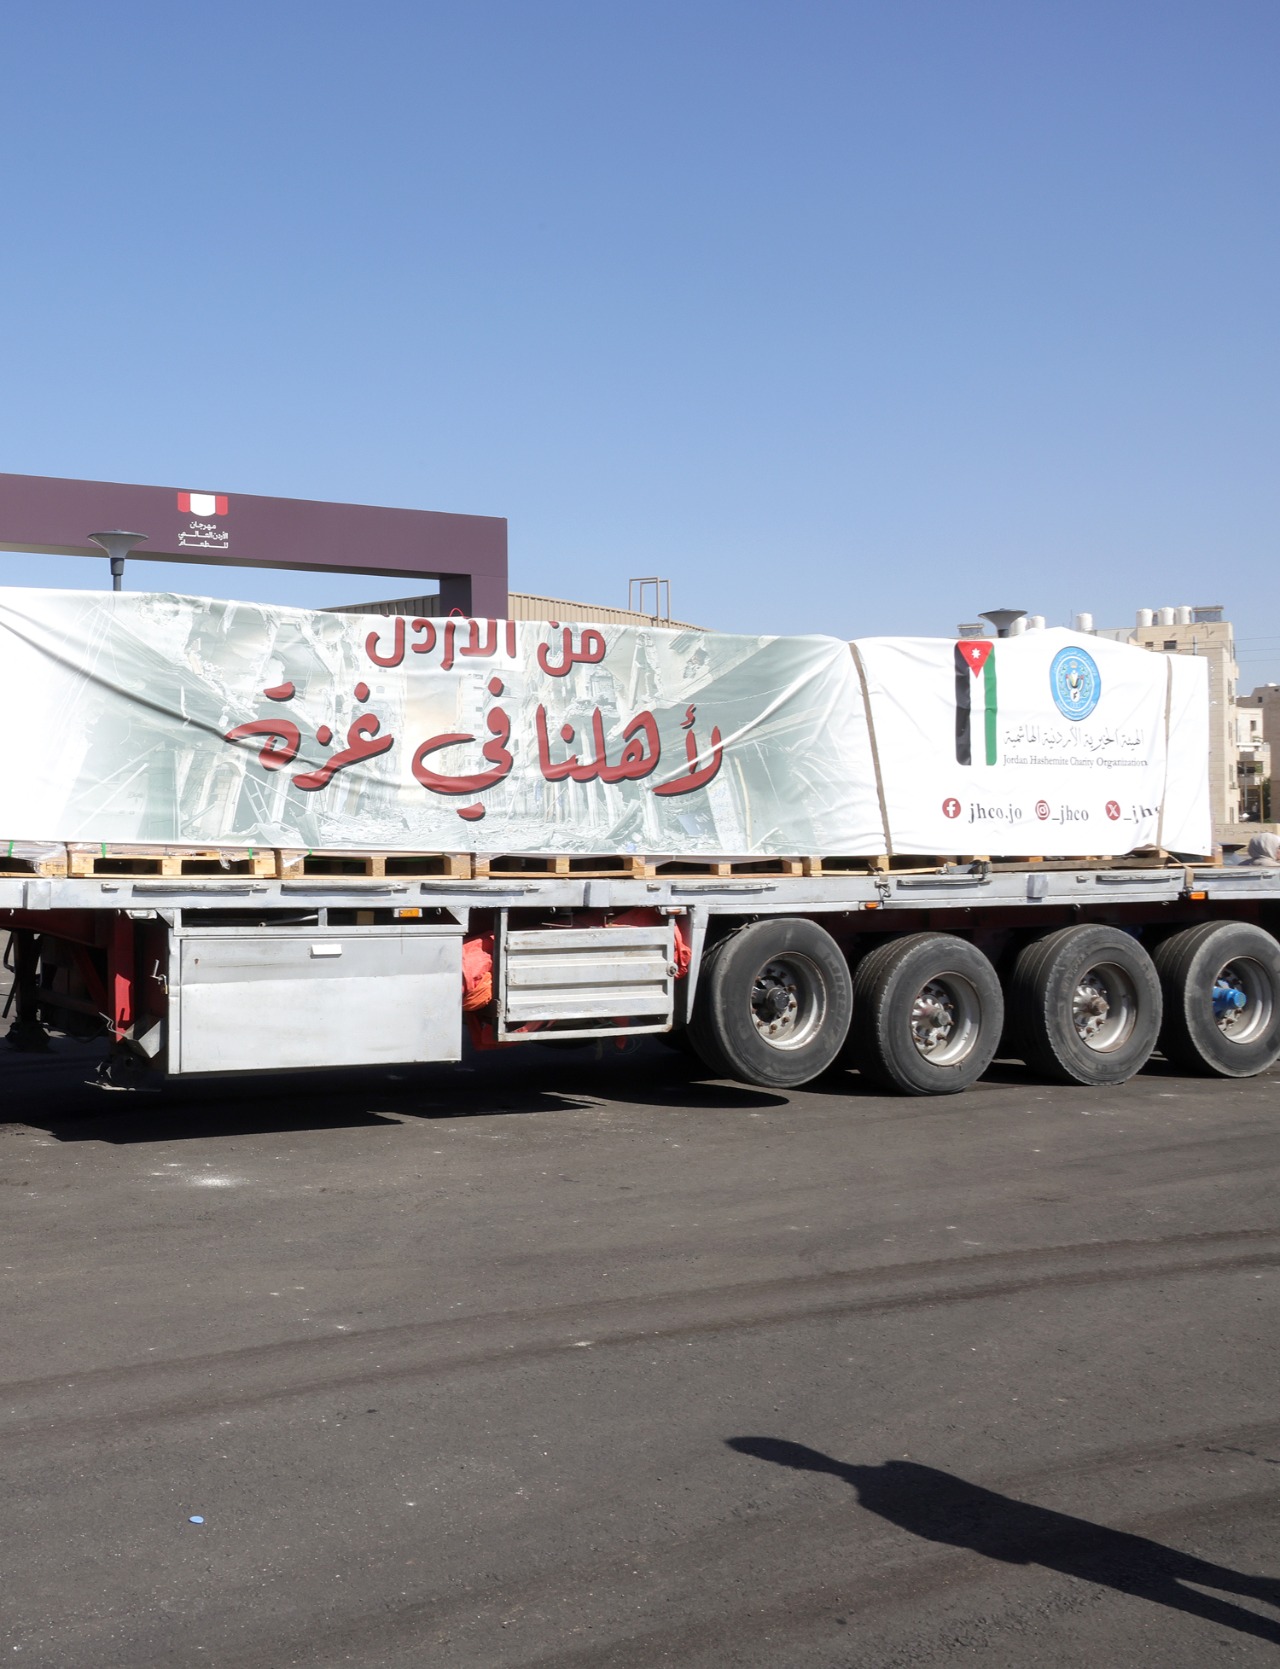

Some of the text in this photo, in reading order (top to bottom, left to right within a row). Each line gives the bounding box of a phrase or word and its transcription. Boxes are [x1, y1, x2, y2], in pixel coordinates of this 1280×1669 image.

[189, 521, 217, 531] مهرجان
[178, 539, 229, 549] للطعام
[536, 621, 607, 677] من
[1003, 724, 1144, 752] الهيئة الخيرية الأردنية الهاشمية
[224, 677, 723, 822] لأهلنا في غزة
[1002, 754, 1149, 770] Jordan Hashemite Charity Organization
[968, 803, 1023, 824] jhco.jo
[1051, 804, 1089, 825] _jhco
